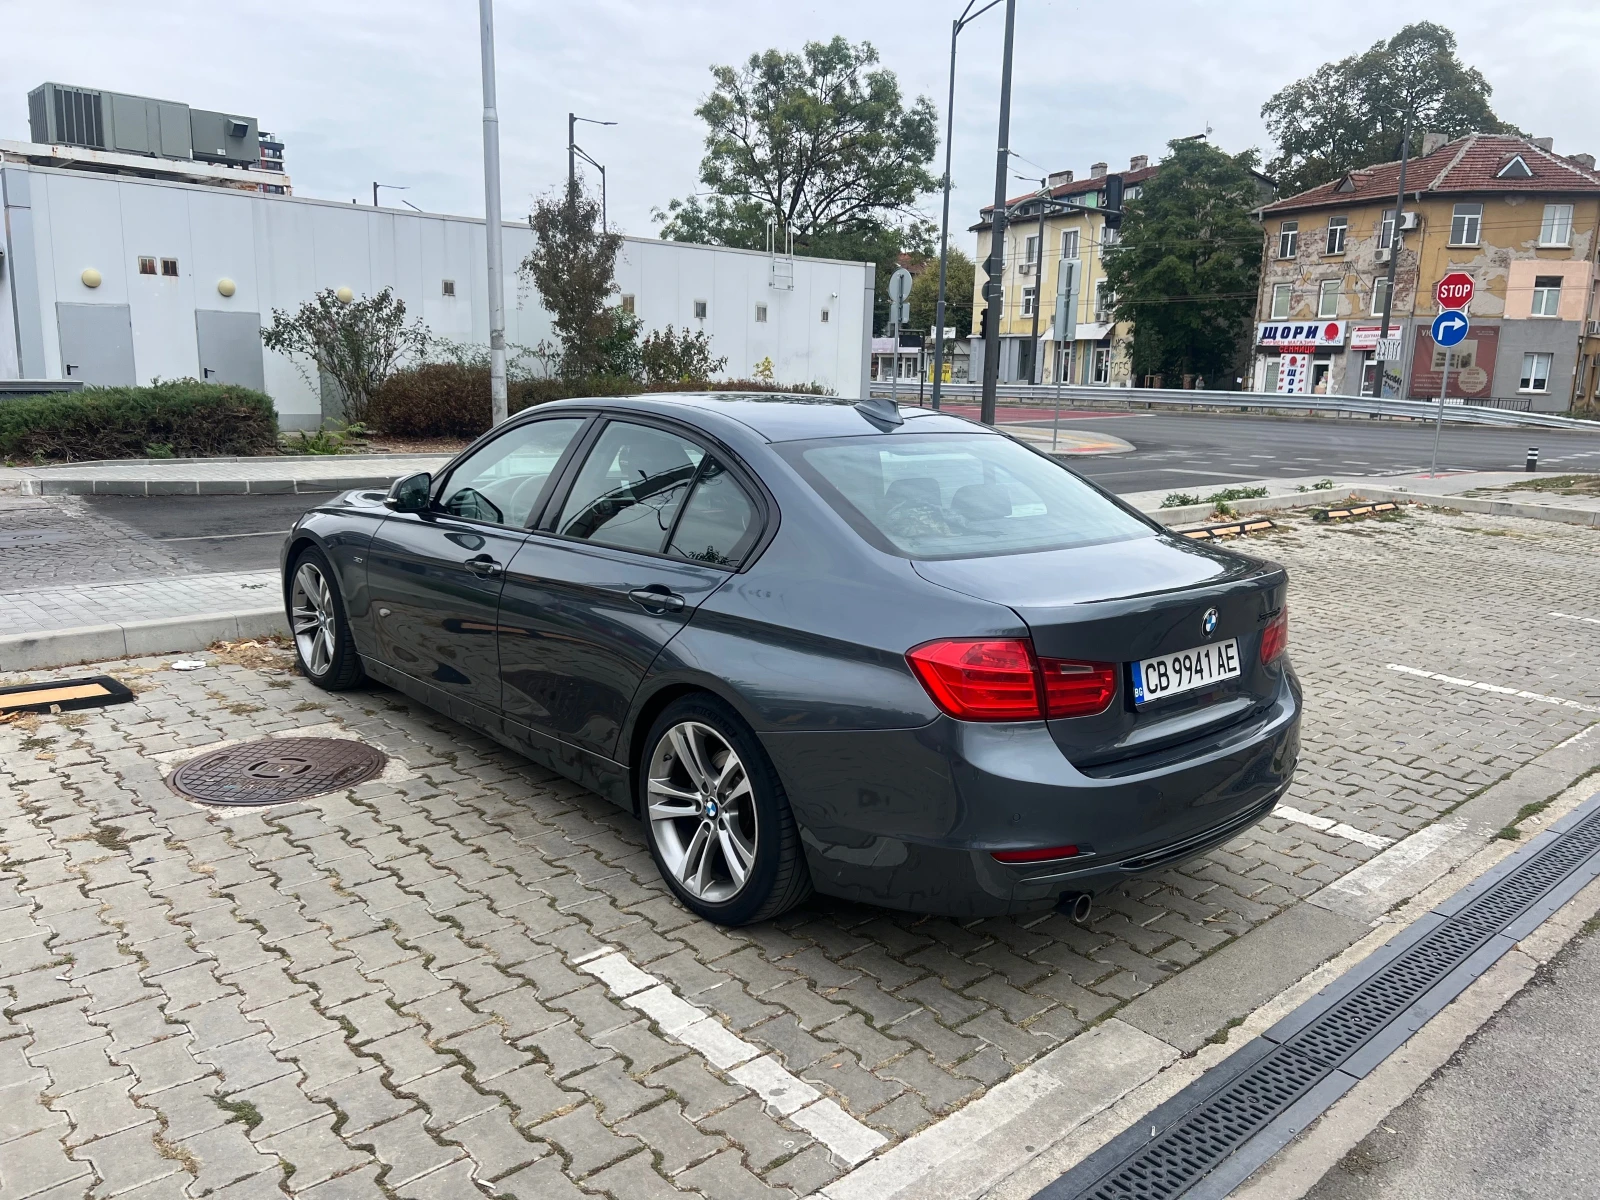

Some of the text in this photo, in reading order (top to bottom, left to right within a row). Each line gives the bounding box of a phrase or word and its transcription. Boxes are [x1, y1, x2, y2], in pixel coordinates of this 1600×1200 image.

[1440, 284, 1471, 298] STOP
[1261, 325, 1319, 340] ЩОРИ
[1145, 643, 1237, 694] CB 9941 AE
[1134, 687, 1144, 697] BG
